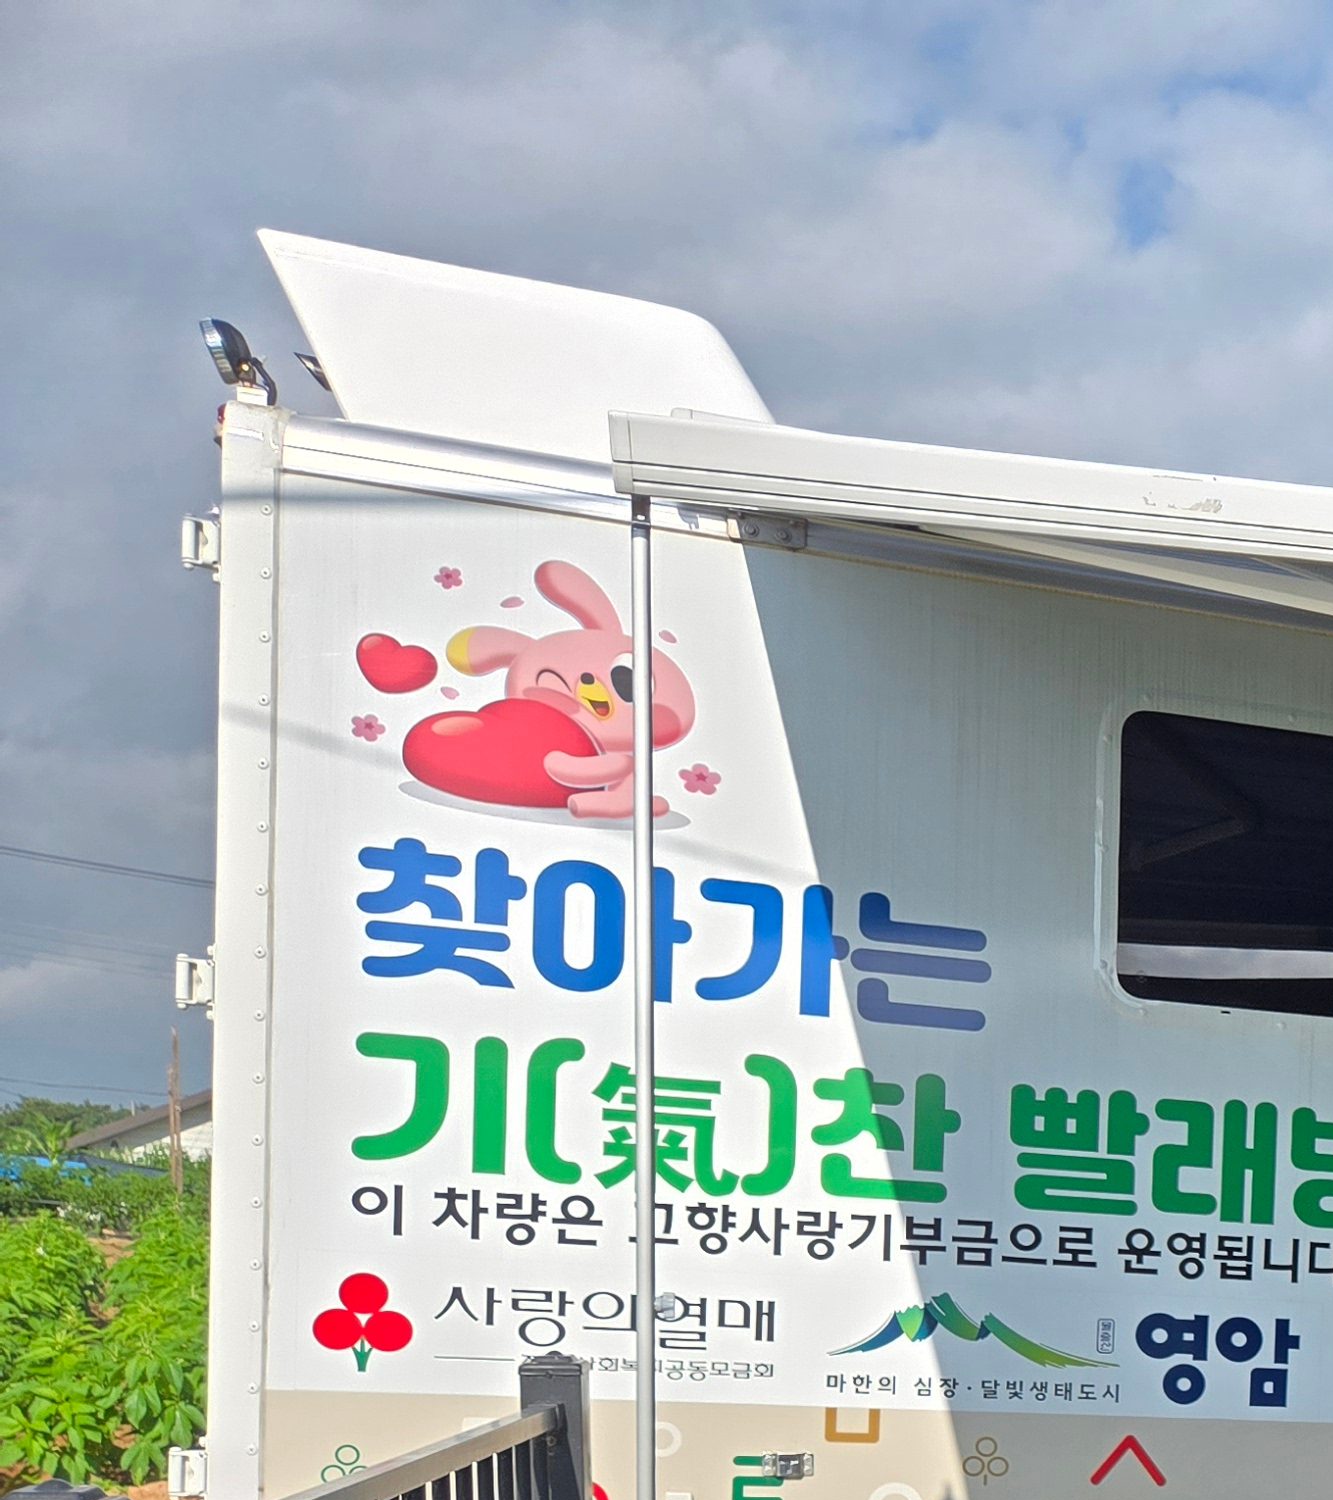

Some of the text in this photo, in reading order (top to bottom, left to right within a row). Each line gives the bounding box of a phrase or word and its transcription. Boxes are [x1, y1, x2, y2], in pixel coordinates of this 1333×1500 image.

[356, 837, 992, 1032] 찾아가는
[351, 1031, 962, 1204] 기(氣)찬
[351, 1184, 404, 1236] 이
[432, 1186, 604, 1247] 차량은
[628, 1201, 1099, 1270] 고향사랑기부금으로
[825, 1373, 898, 1395] 마한의
[1135, 1312, 1301, 1408] 영암
